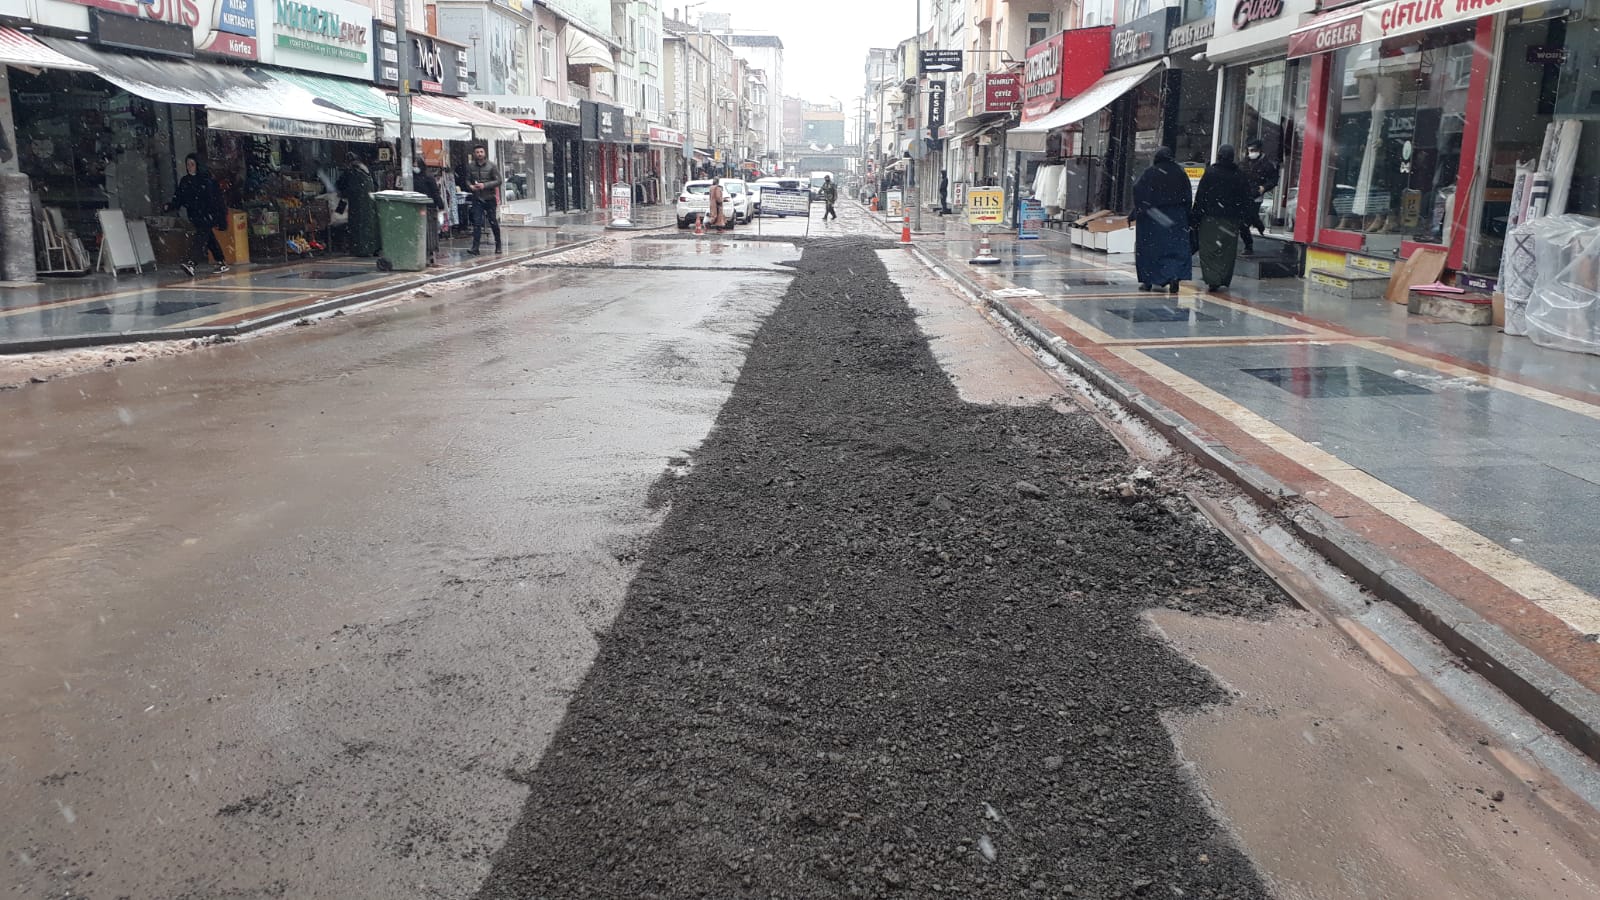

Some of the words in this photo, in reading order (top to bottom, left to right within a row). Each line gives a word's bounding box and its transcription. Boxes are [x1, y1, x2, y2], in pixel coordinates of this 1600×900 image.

[1316, 24, 1357, 48] ÖGELER
[229, 40, 252, 54] Körfez
[933, 85, 941, 121] DESEN
[974, 194, 999, 207] HİS
